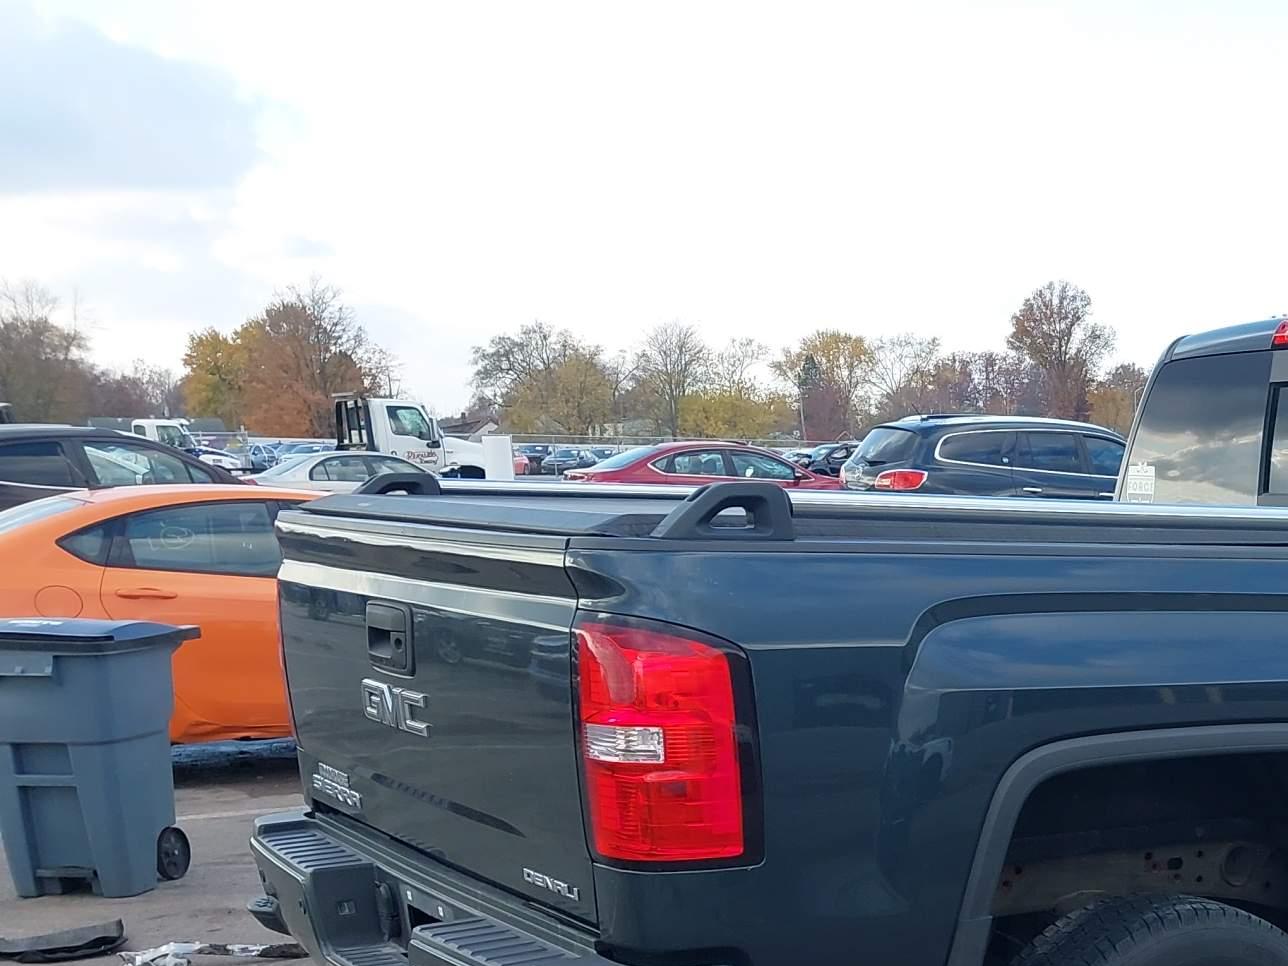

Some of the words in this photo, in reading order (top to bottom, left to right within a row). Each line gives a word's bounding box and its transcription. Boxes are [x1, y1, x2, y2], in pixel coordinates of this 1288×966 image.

[361, 678, 431, 738] GMC
[312, 773, 361, 808] SIERRA
[522, 867, 579, 902] DENALI
